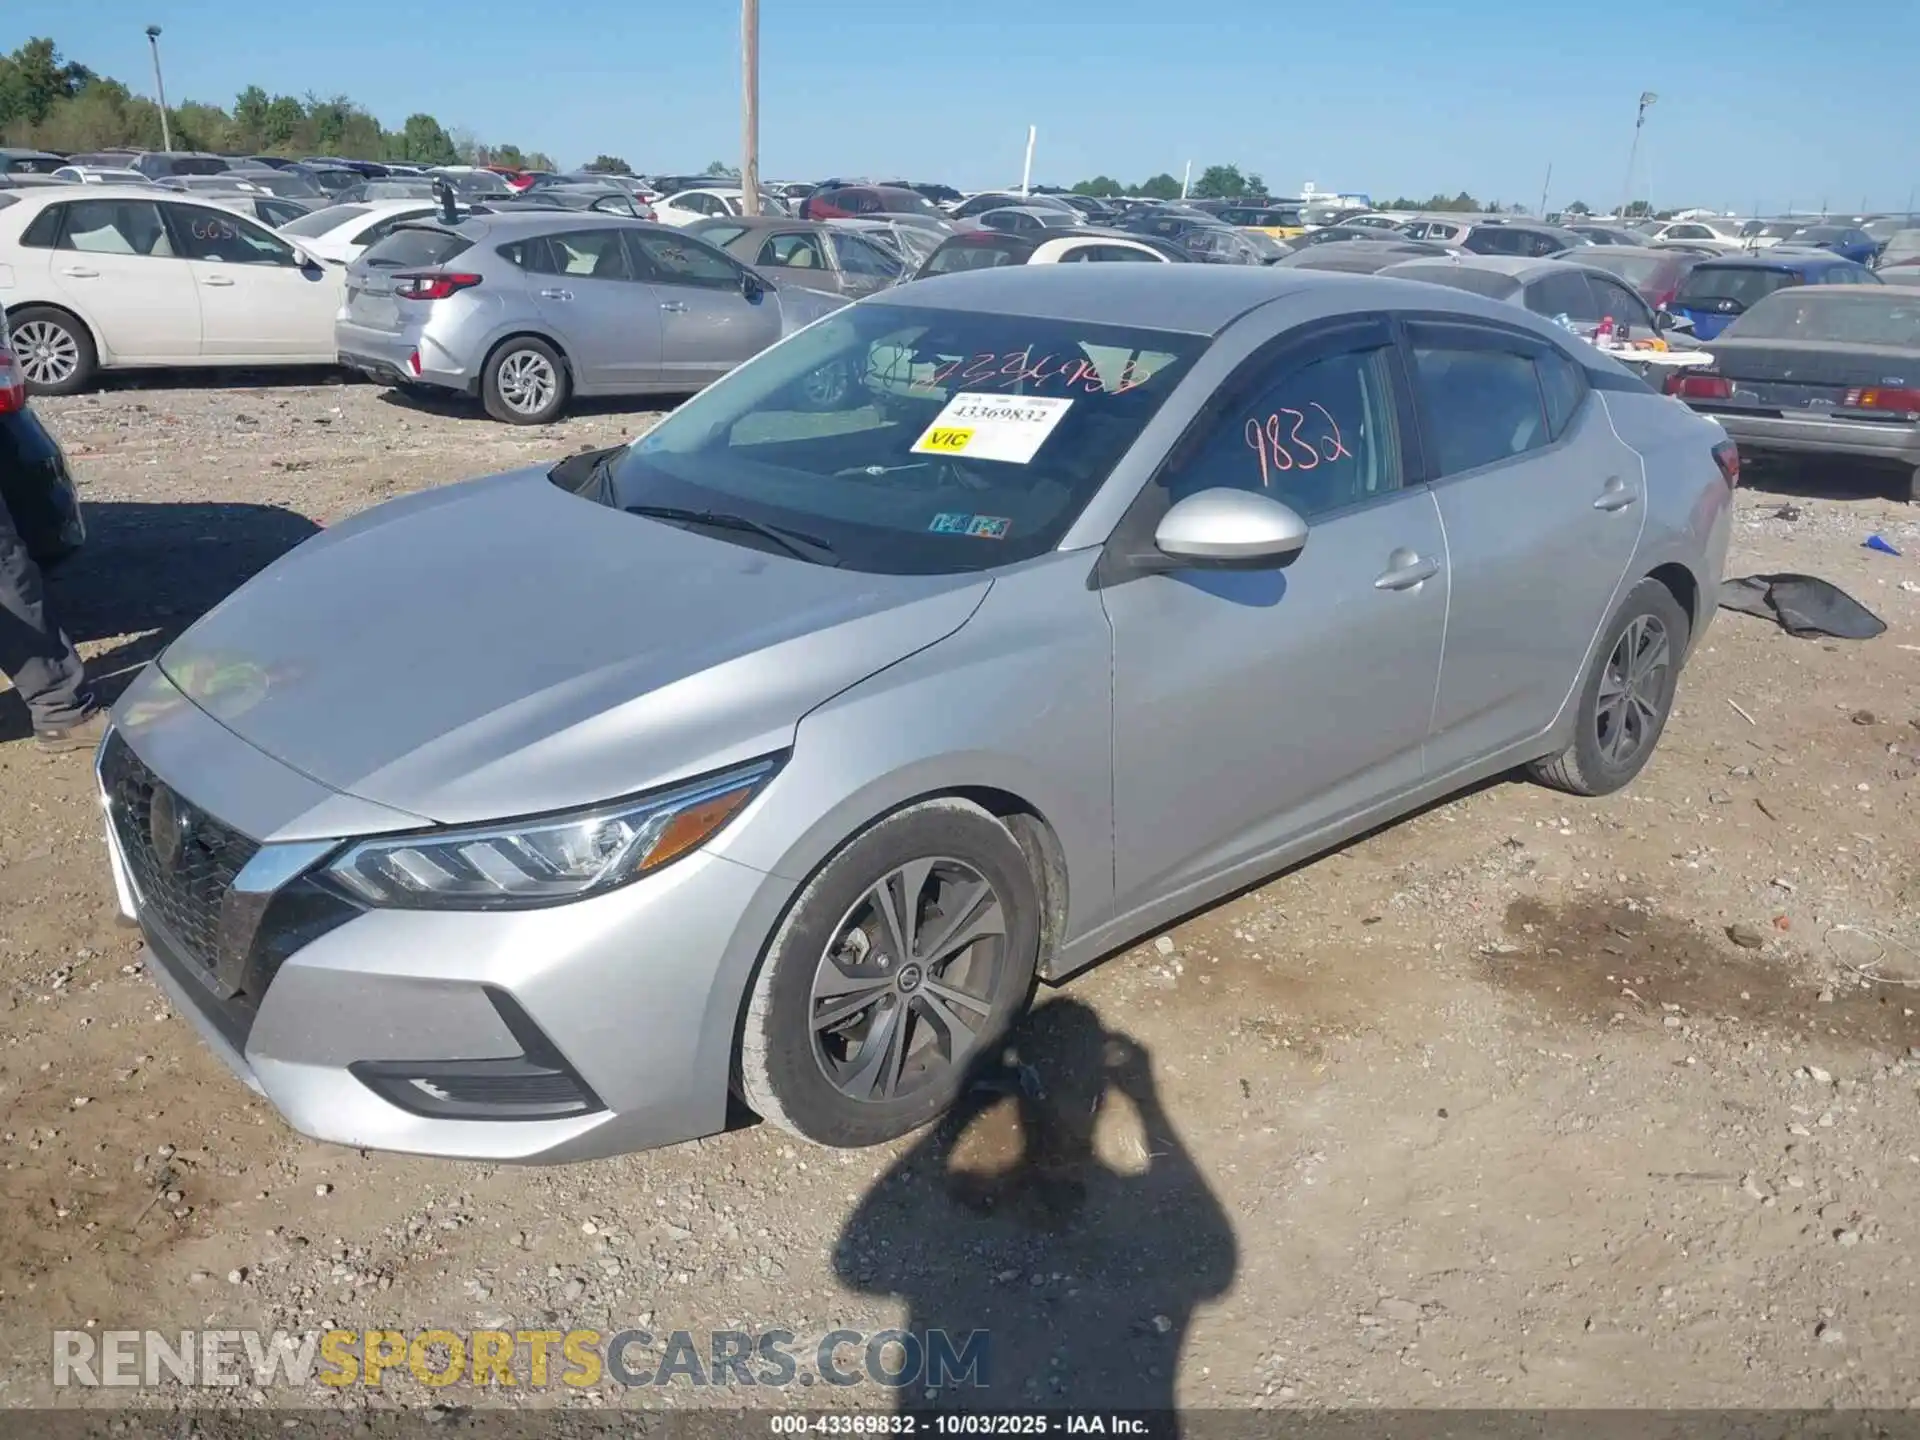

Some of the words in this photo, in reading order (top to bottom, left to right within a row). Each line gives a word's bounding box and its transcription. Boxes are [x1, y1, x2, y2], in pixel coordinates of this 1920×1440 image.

[953, 405, 1048, 422] 43369832
[931, 431, 968, 447] VIC
[1245, 402, 1352, 487] 9832
